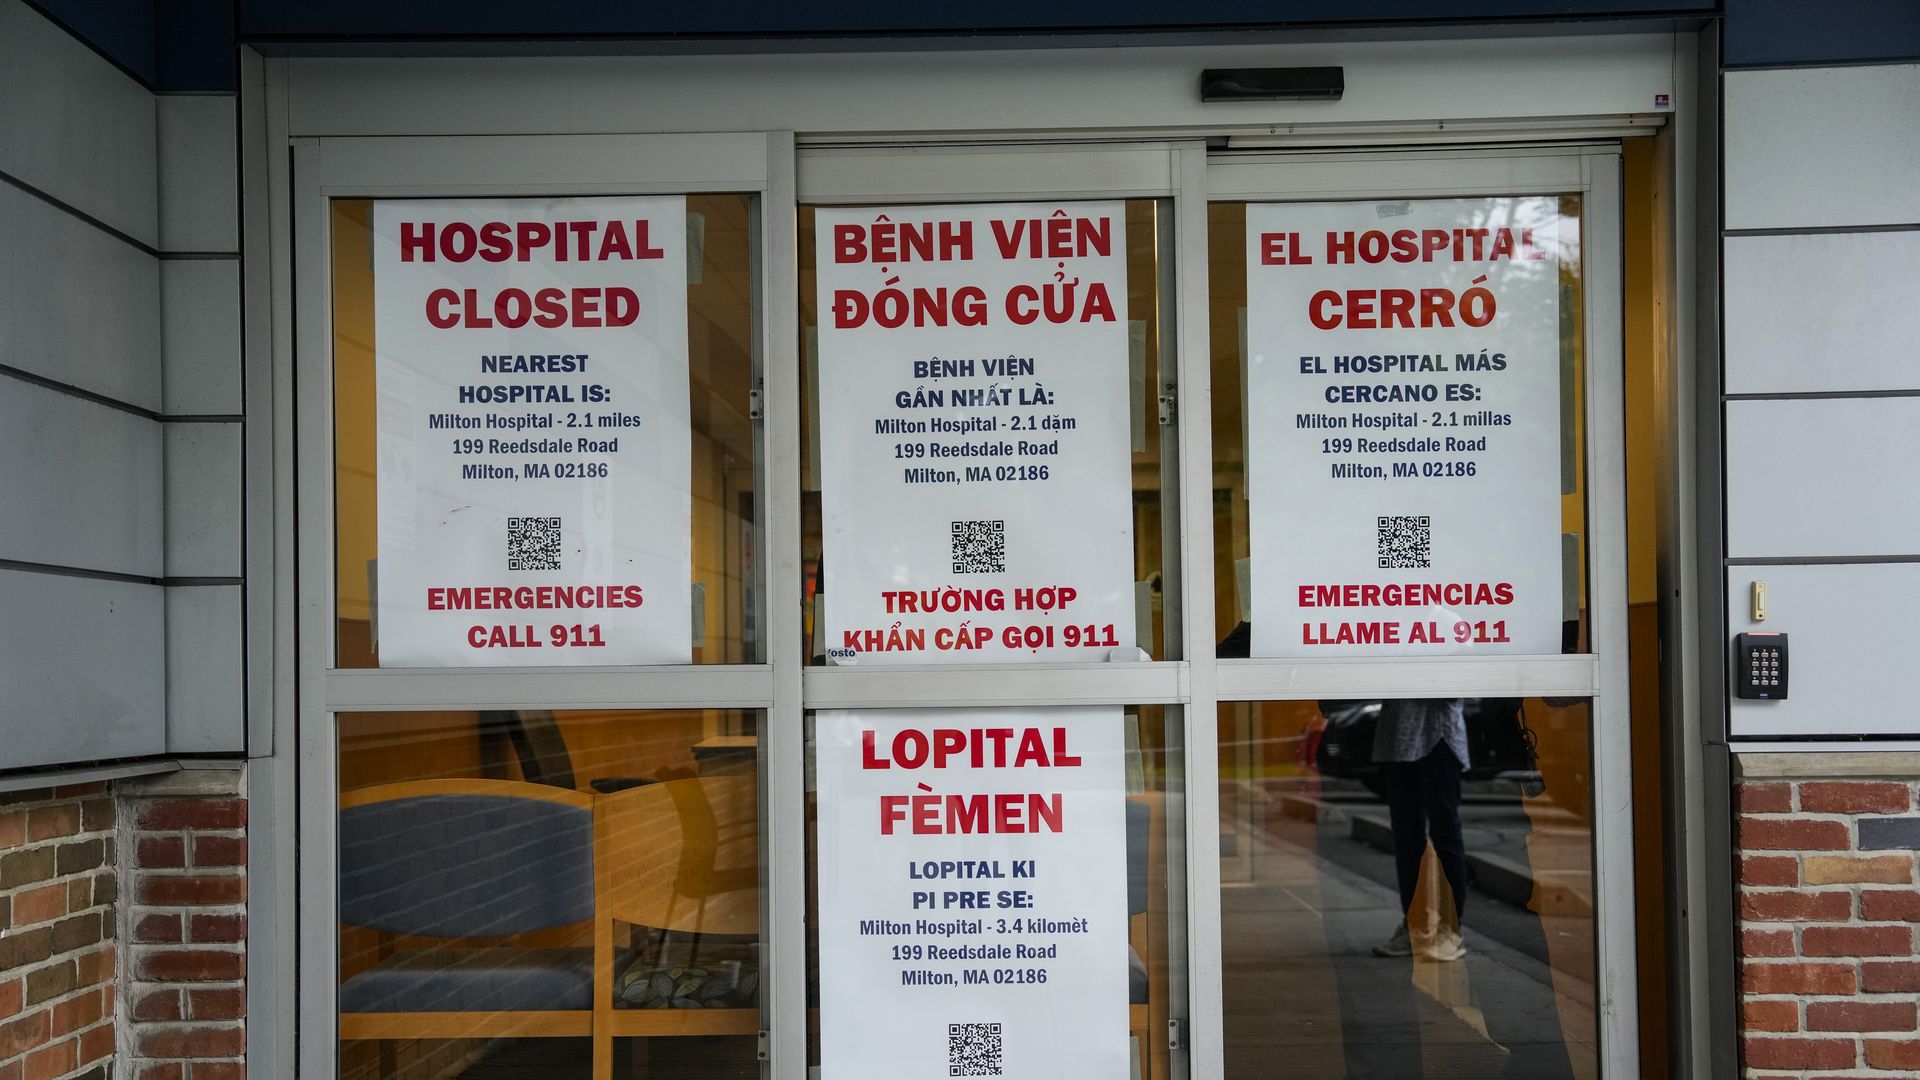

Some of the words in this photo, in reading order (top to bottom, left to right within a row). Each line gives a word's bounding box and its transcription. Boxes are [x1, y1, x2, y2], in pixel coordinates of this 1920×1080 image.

[401, 220, 664, 263] HOSPITAL
[834, 215, 973, 273] BỆNH
[990, 210, 1110, 268] VIỆN
[1261, 232, 1312, 265] EL
[1327, 228, 1545, 264] HOSPITAL
[426, 287, 640, 329] CLOSED
[832, 276, 987, 329] ĐÓNG
[1005, 271, 1116, 325] CỬA
[1309, 274, 1496, 330] CERRÓ
[482, 355, 588, 373] NEAREST
[914, 357, 974, 382] BỆNH
[982, 355, 1034, 380] VIỆN
[1300, 357, 1327, 374] EL
[1334, 354, 1448, 373] HOSPITAL
[1456, 348, 1507, 371] MÁS
[459, 385, 574, 403] HOSPITAL
[582, 385, 610, 402] IS:
[896, 385, 943, 409] GẦN
[952, 383, 1012, 407] NHẤT
[1019, 382, 1054, 405] LÀ:
[1325, 384, 1438, 403] CERCANO
[1446, 384, 1481, 401] ES:
[430, 414, 481, 429] Milton
[486, 413, 552, 432] Hospital
[567, 412, 593, 428] 2.1
[598, 412, 640, 427] miles
[876, 419, 926, 434] Milton
[931, 416, 996, 435] Hospital
[1011, 415, 1037, 431] 2.1
[1041, 415, 1076, 433] dặm
[1297, 414, 1347, 428] Milton
[1352, 412, 1417, 431] Hospital
[1432, 411, 1458, 427] 2.1
[1463, 411, 1511, 426] millas
[453, 439, 483, 454] 199
[489, 438, 572, 454] Reedsdale
[578, 438, 618, 453] Road
[895, 443, 925, 458] 199
[930, 441, 1013, 458] Reedsdale
[1018, 440, 1058, 455] Road
[1323, 438, 1352, 453] 199
[1358, 437, 1440, 453] Reedsdale
[1446, 436, 1486, 452] Road
[463, 464, 519, 481] Milton,
[524, 463, 550, 478] MA
[554, 463, 608, 478] 02186
[905, 468, 960, 485] Milton,
[966, 467, 992, 482] MA
[996, 465, 1049, 481] 02186
[1332, 463, 1387, 480] Milton,
[1393, 462, 1419, 477] MA
[1423, 461, 1476, 477] 02186
[428, 585, 643, 610] EMERGENCIES
[882, 585, 1005, 613] TRƯỜNG
[1015, 585, 1077, 615] HỢP
[1298, 583, 1514, 607] EMERGENCIAS
[468, 625, 542, 648] CALL
[550, 624, 605, 647] 911
[843, 619, 926, 653] KHẨN
[935, 620, 993, 650] CẤP
[1002, 626, 1054, 653] GỌI
[1063, 624, 1120, 647] 911
[1303, 622, 1400, 645] LLAME
[1408, 621, 1445, 644] AL
[1454, 620, 1510, 643] 911
[828, 648, 856, 657] osto
[862, 727, 1082, 770] LOPITAL
[880, 782, 1062, 835] FÈMEN
[910, 861, 1005, 879] LOPITAL
[1012, 860, 1035, 878] KI
[913, 892, 935, 909] PI
[943, 891, 990, 909] PRE
[997, 891, 1033, 909] SE:
[860, 920, 911, 935] Milton
[916, 919, 982, 938] Hospital
[996, 918, 1023, 934] 3.4
[1028, 917, 1088, 934] kilomèt
[892, 945, 922, 960] 199
[928, 944, 1011, 960] Reedsdale
[1016, 944, 1056, 959] Road
[902, 969, 958, 988] Milton,
[963, 969, 989, 984] MA
[993, 969, 1047, 984] 02186
